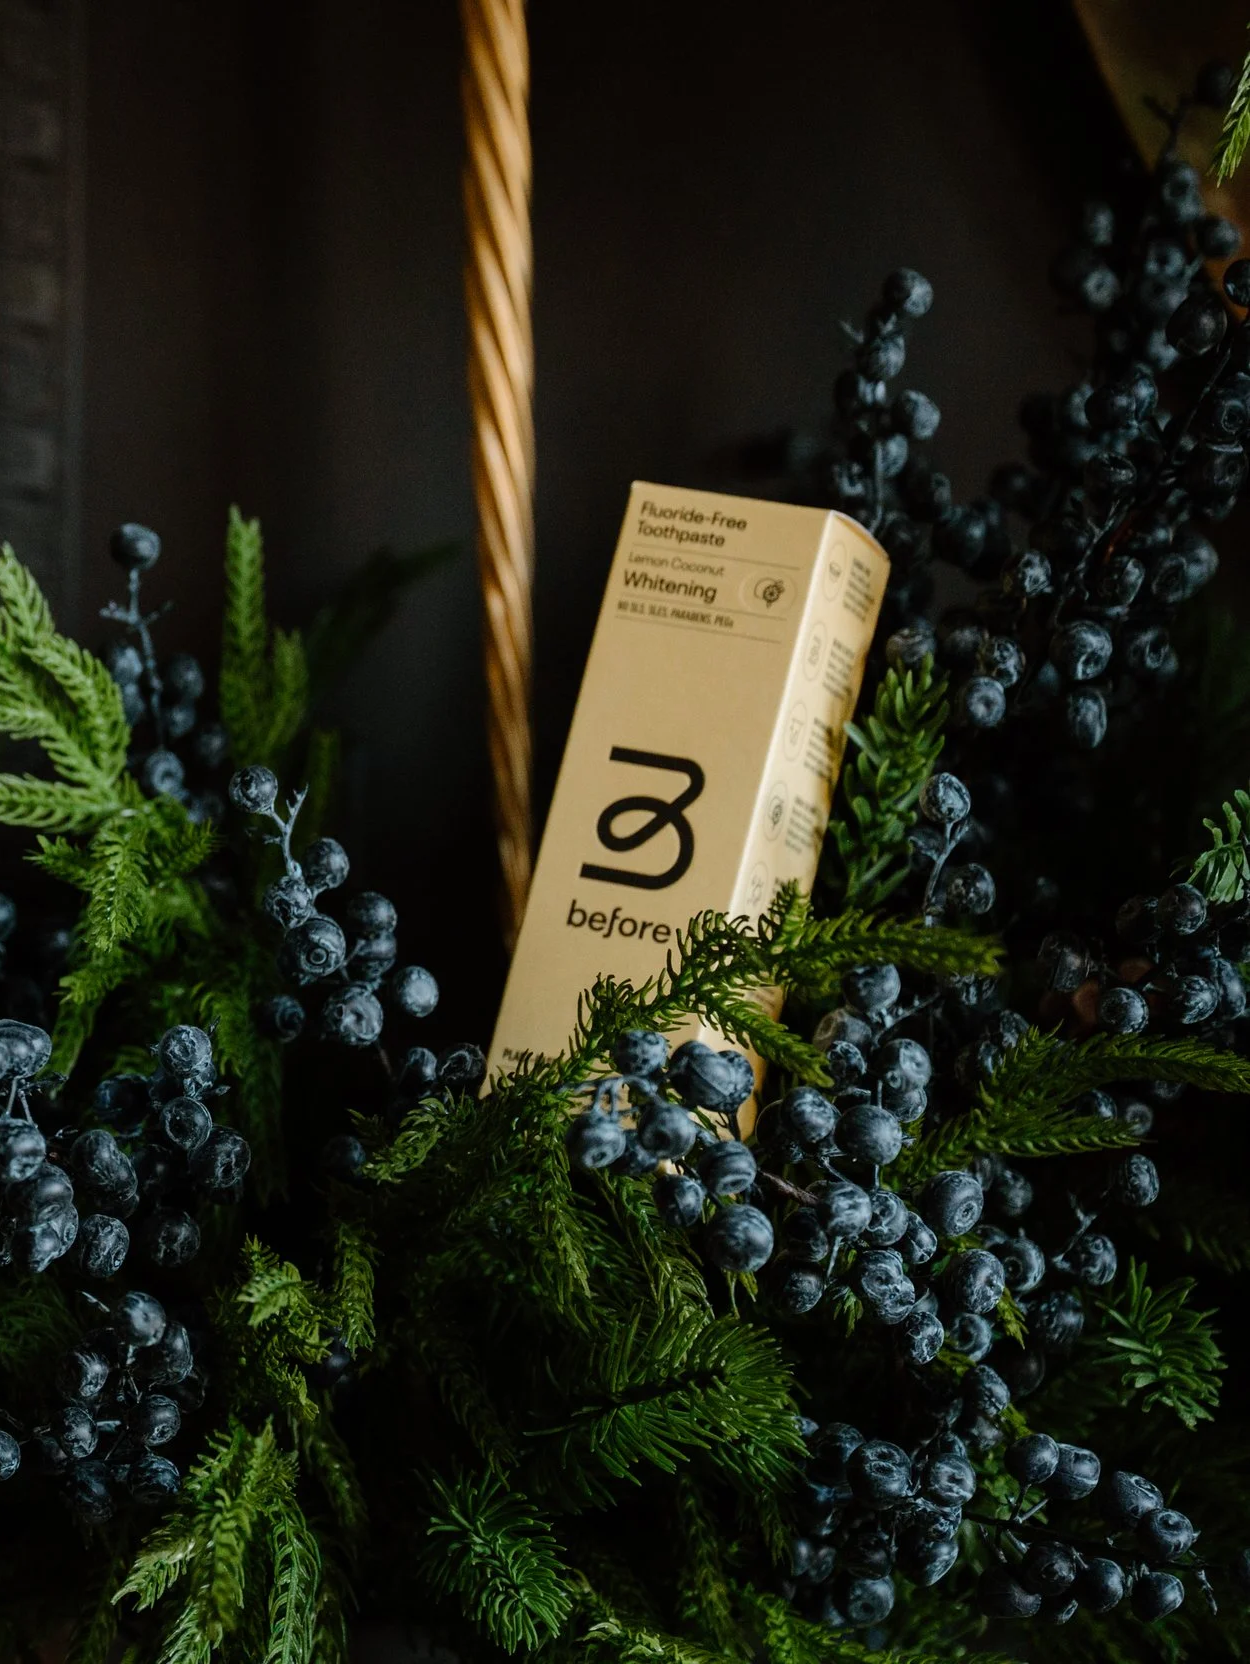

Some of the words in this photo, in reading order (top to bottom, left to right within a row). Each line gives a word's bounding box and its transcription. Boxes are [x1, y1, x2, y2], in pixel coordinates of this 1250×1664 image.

[640, 500, 748, 532] Fluoride-Free
[637, 519, 726, 547] Toothpaste
[627, 550, 668, 568] Lemon
[670, 556, 726, 579] Coconut
[623, 568, 719, 604] Whitening
[566, 899, 672, 944] before
